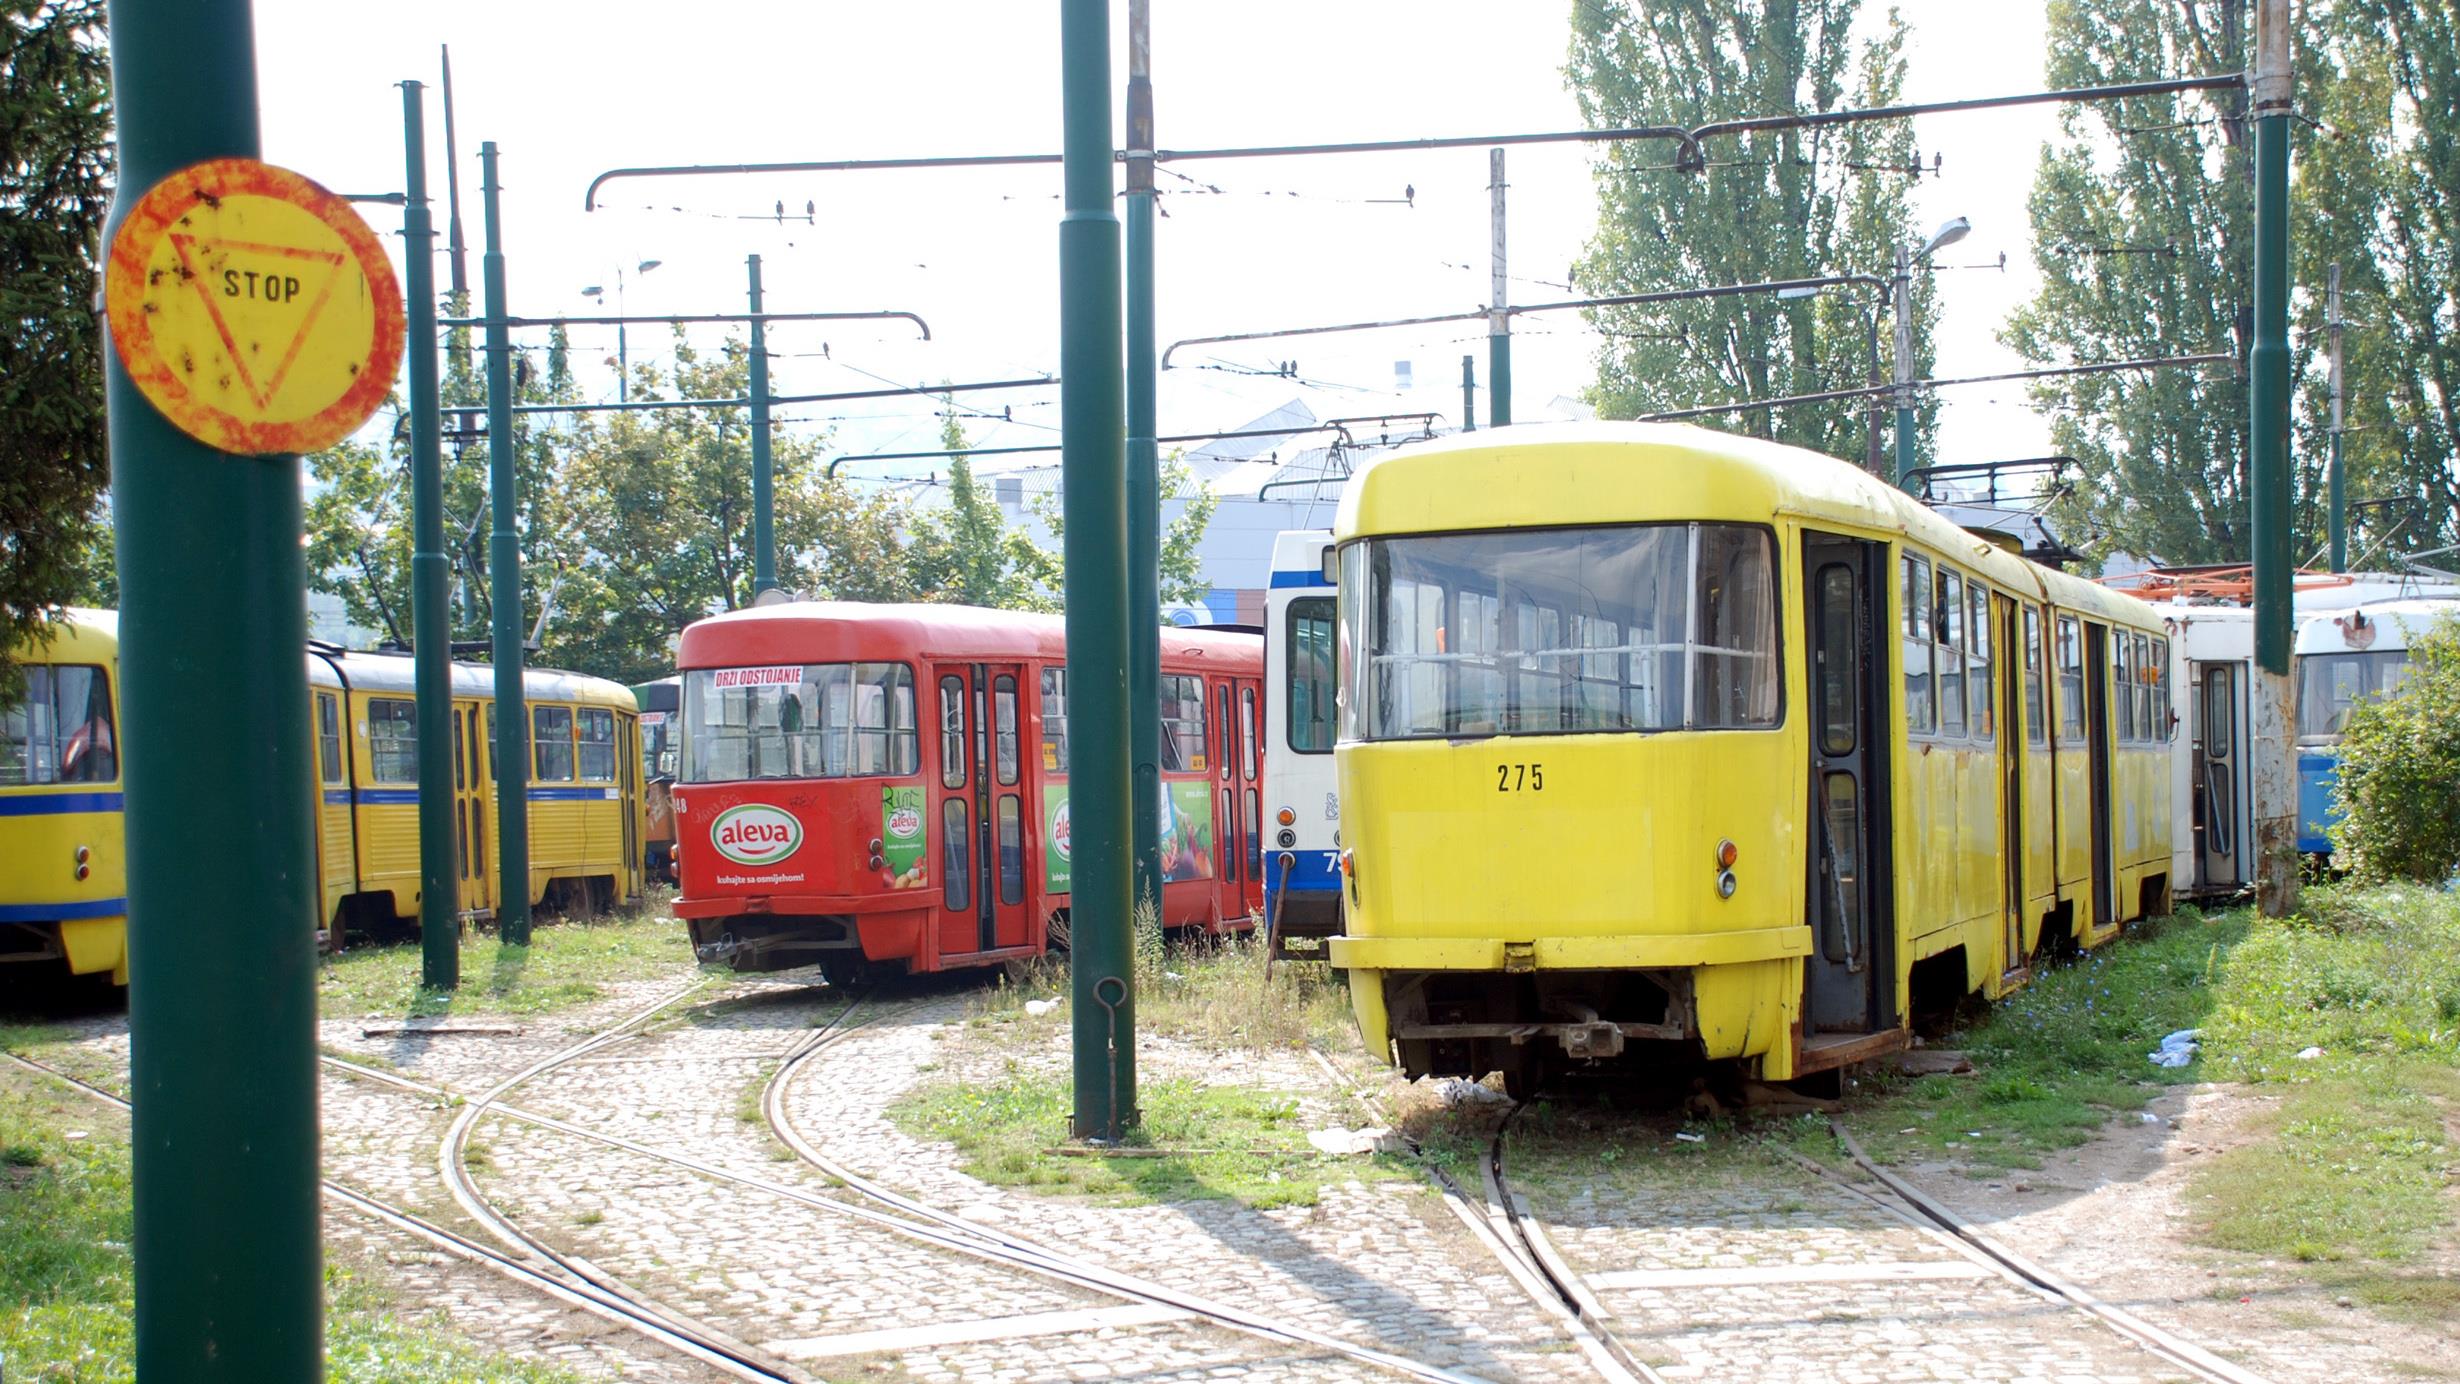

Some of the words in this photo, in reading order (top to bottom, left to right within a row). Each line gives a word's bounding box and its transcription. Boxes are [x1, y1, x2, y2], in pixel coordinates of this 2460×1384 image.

[224, 269, 300, 303] STOP
[739, 668, 801, 685] ODSTOJANJE
[1497, 764, 1543, 792] 275
[721, 819, 790, 845] aleva
